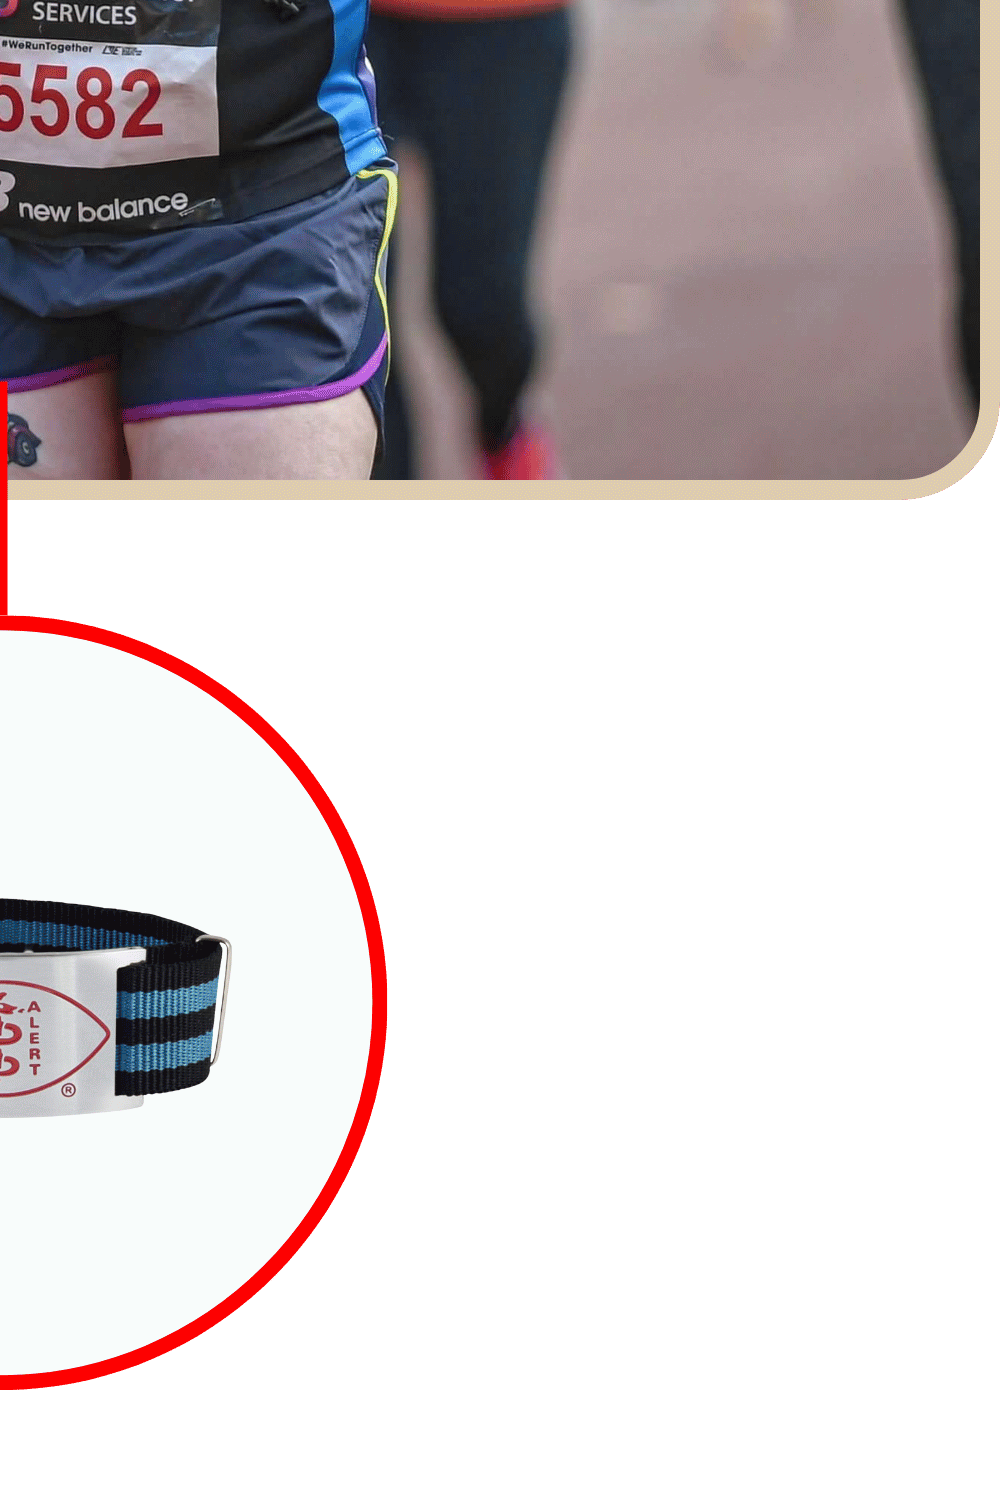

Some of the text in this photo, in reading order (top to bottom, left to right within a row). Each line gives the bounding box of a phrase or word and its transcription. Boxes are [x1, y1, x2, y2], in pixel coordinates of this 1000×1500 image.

[32, 1, 138, 27] SERVICES
[1, 39, 94, 56] #WeRunTogether
[18, 191, 189, 223] new balance
